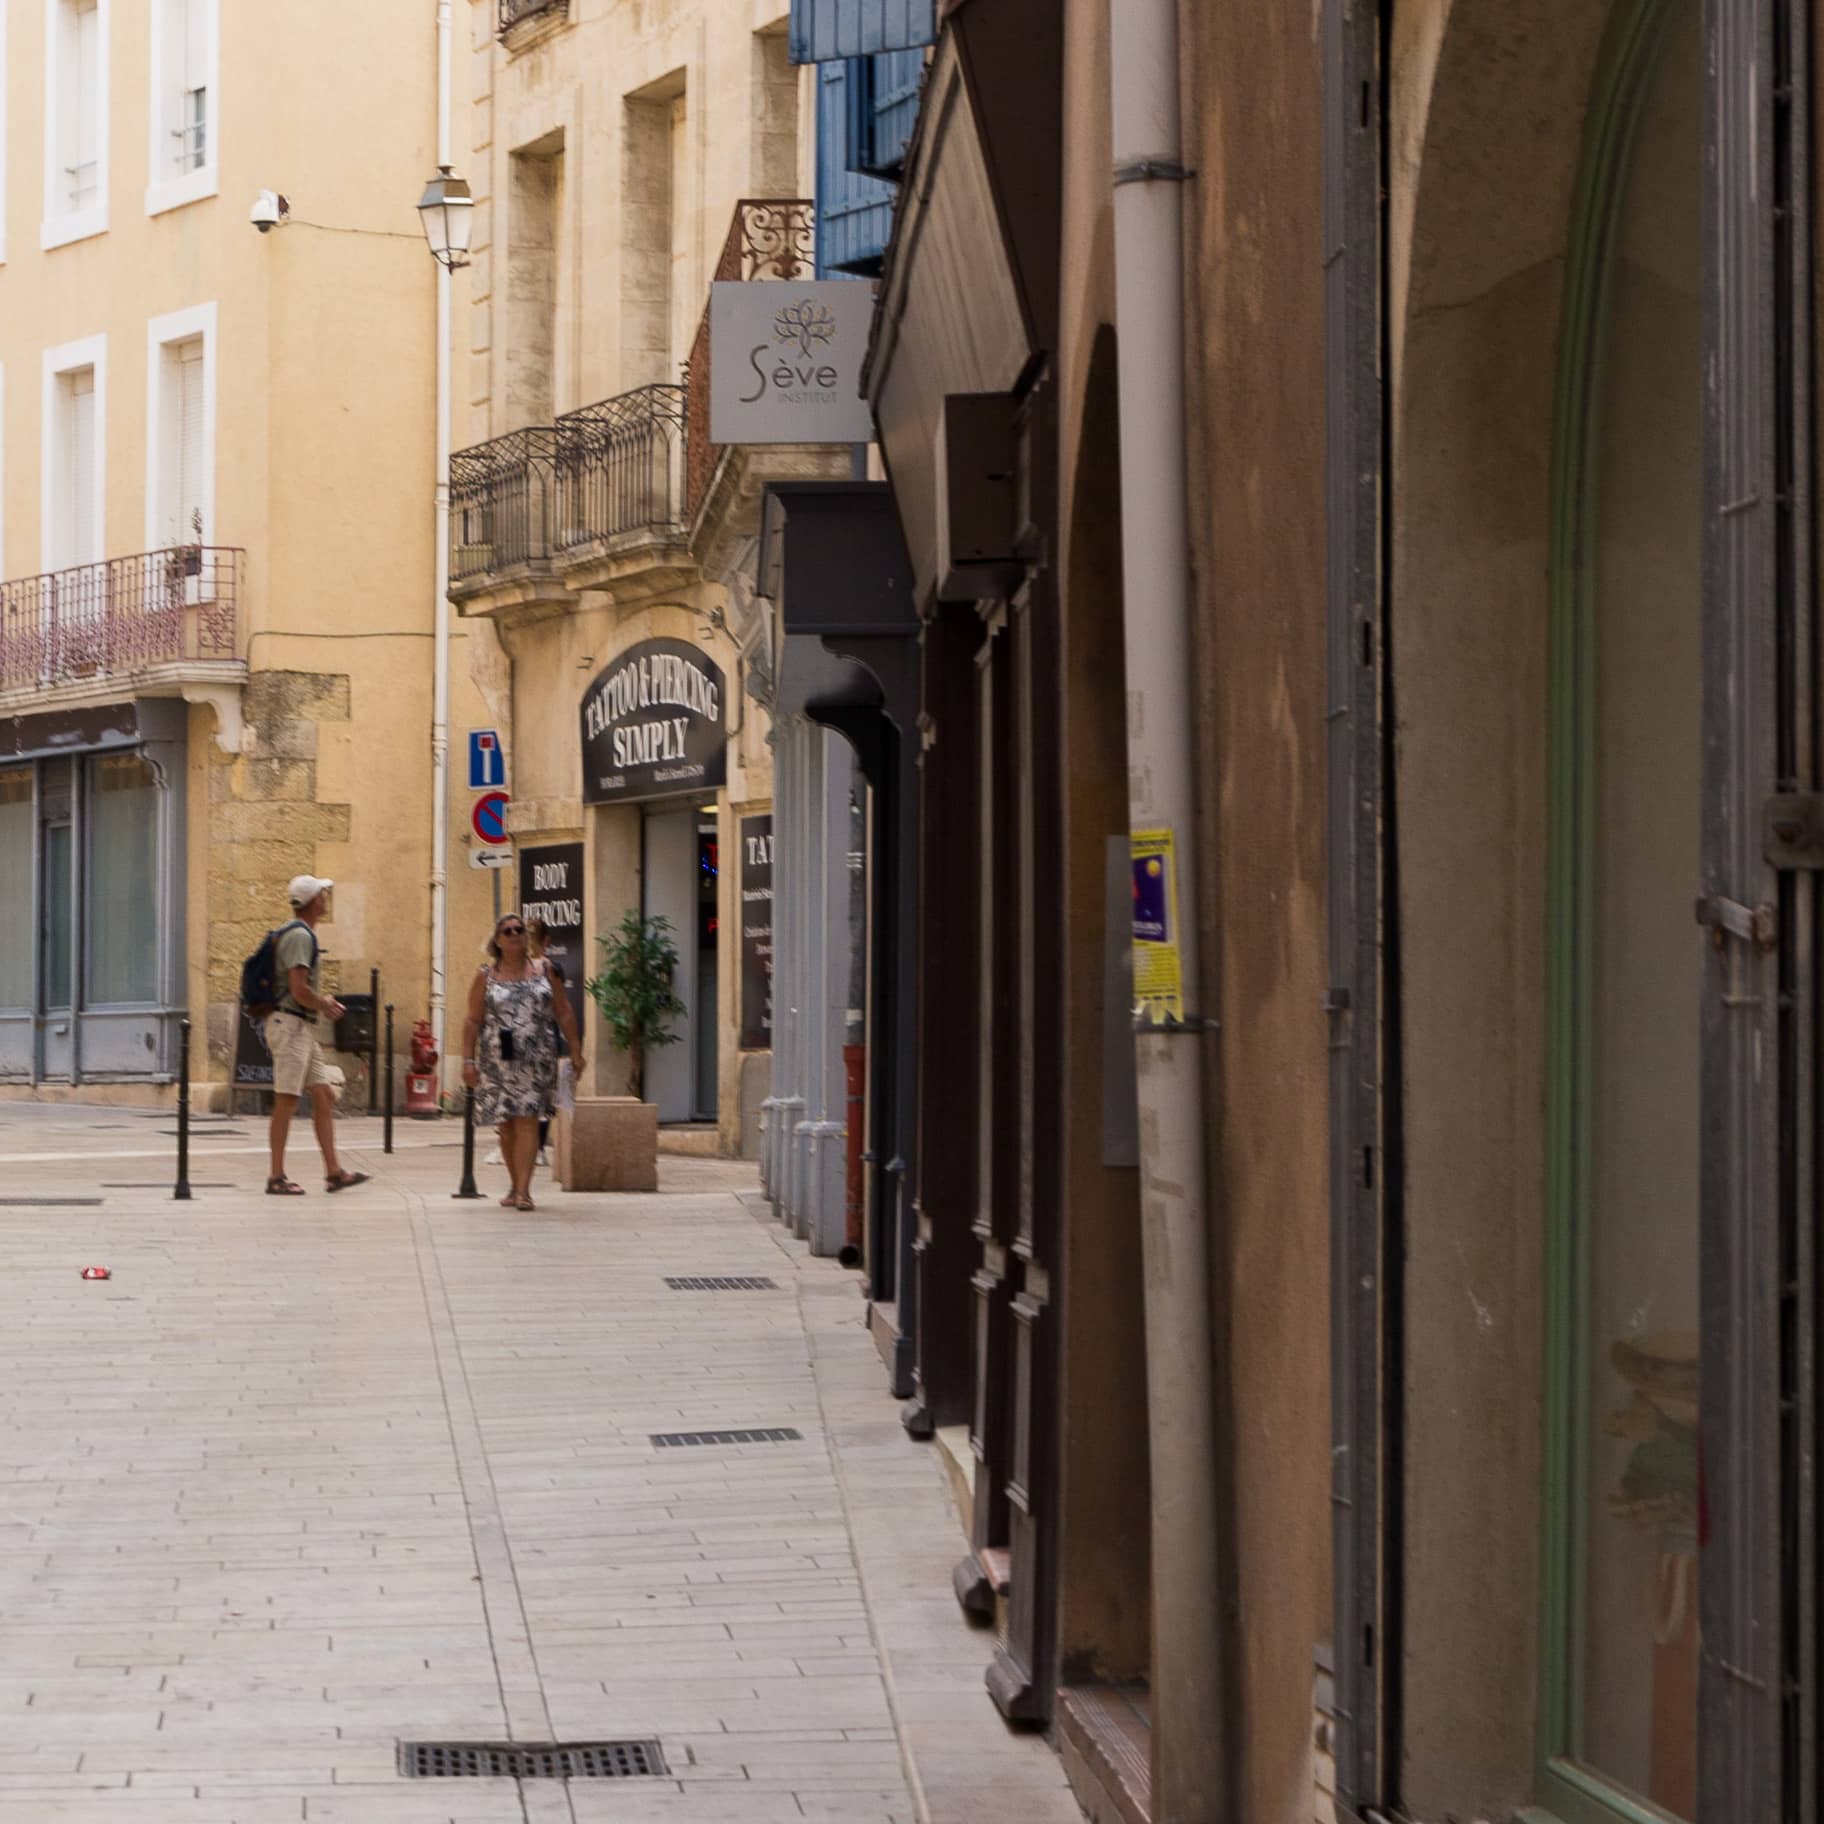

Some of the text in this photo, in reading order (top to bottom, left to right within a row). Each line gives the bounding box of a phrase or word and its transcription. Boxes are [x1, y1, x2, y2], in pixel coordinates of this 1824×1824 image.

[739, 344, 838, 404] Sève
[778, 391, 838, 405] INSTITUT
[613, 717, 689, 768] SIMPLY
[533, 862, 569, 891] BODY
